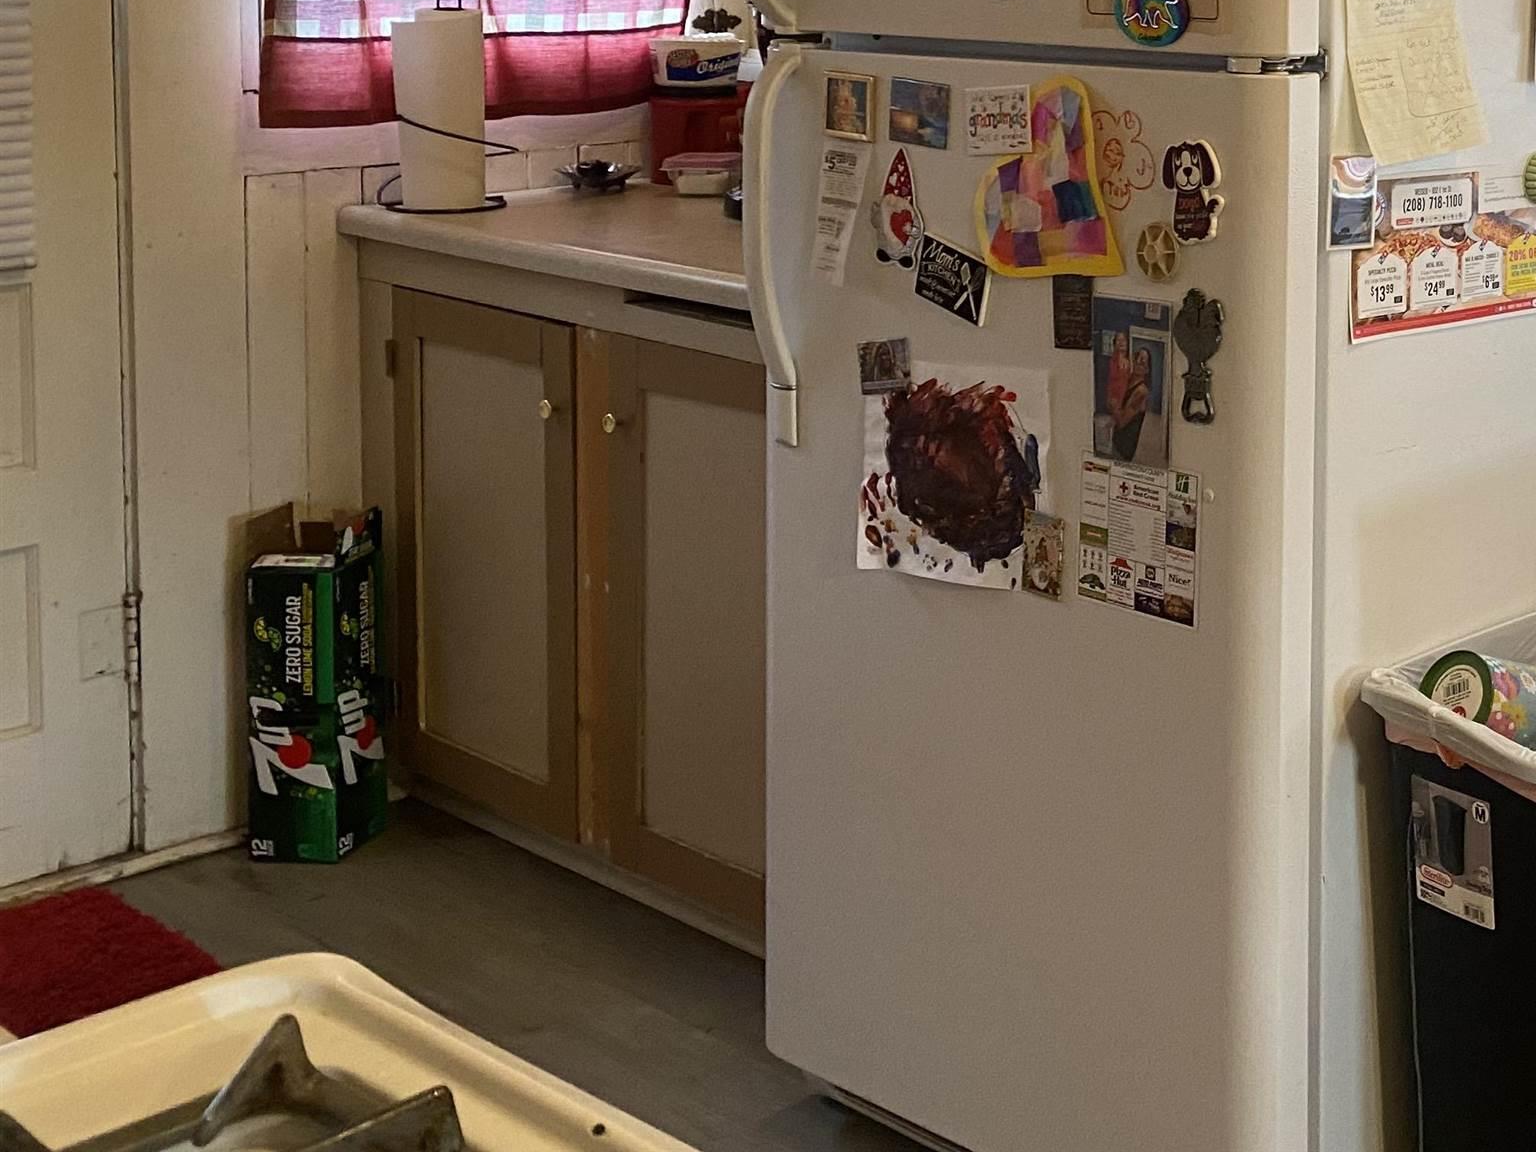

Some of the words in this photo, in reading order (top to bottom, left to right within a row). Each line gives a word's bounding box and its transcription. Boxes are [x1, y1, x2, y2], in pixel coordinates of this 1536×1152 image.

[1403, 197, 1426, 214] (208)
[1429, 193, 1463, 210] 718-1100
[922, 239, 961, 272] Mom's
[1509, 249, 1527, 262] 20%
[285, 595, 302, 645] SUGAR
[359, 580, 369, 630] SUGAR
[285, 647, 302, 684] ZERO
[360, 631, 370, 668] ZERO
[252, 838, 266, 857] 12
